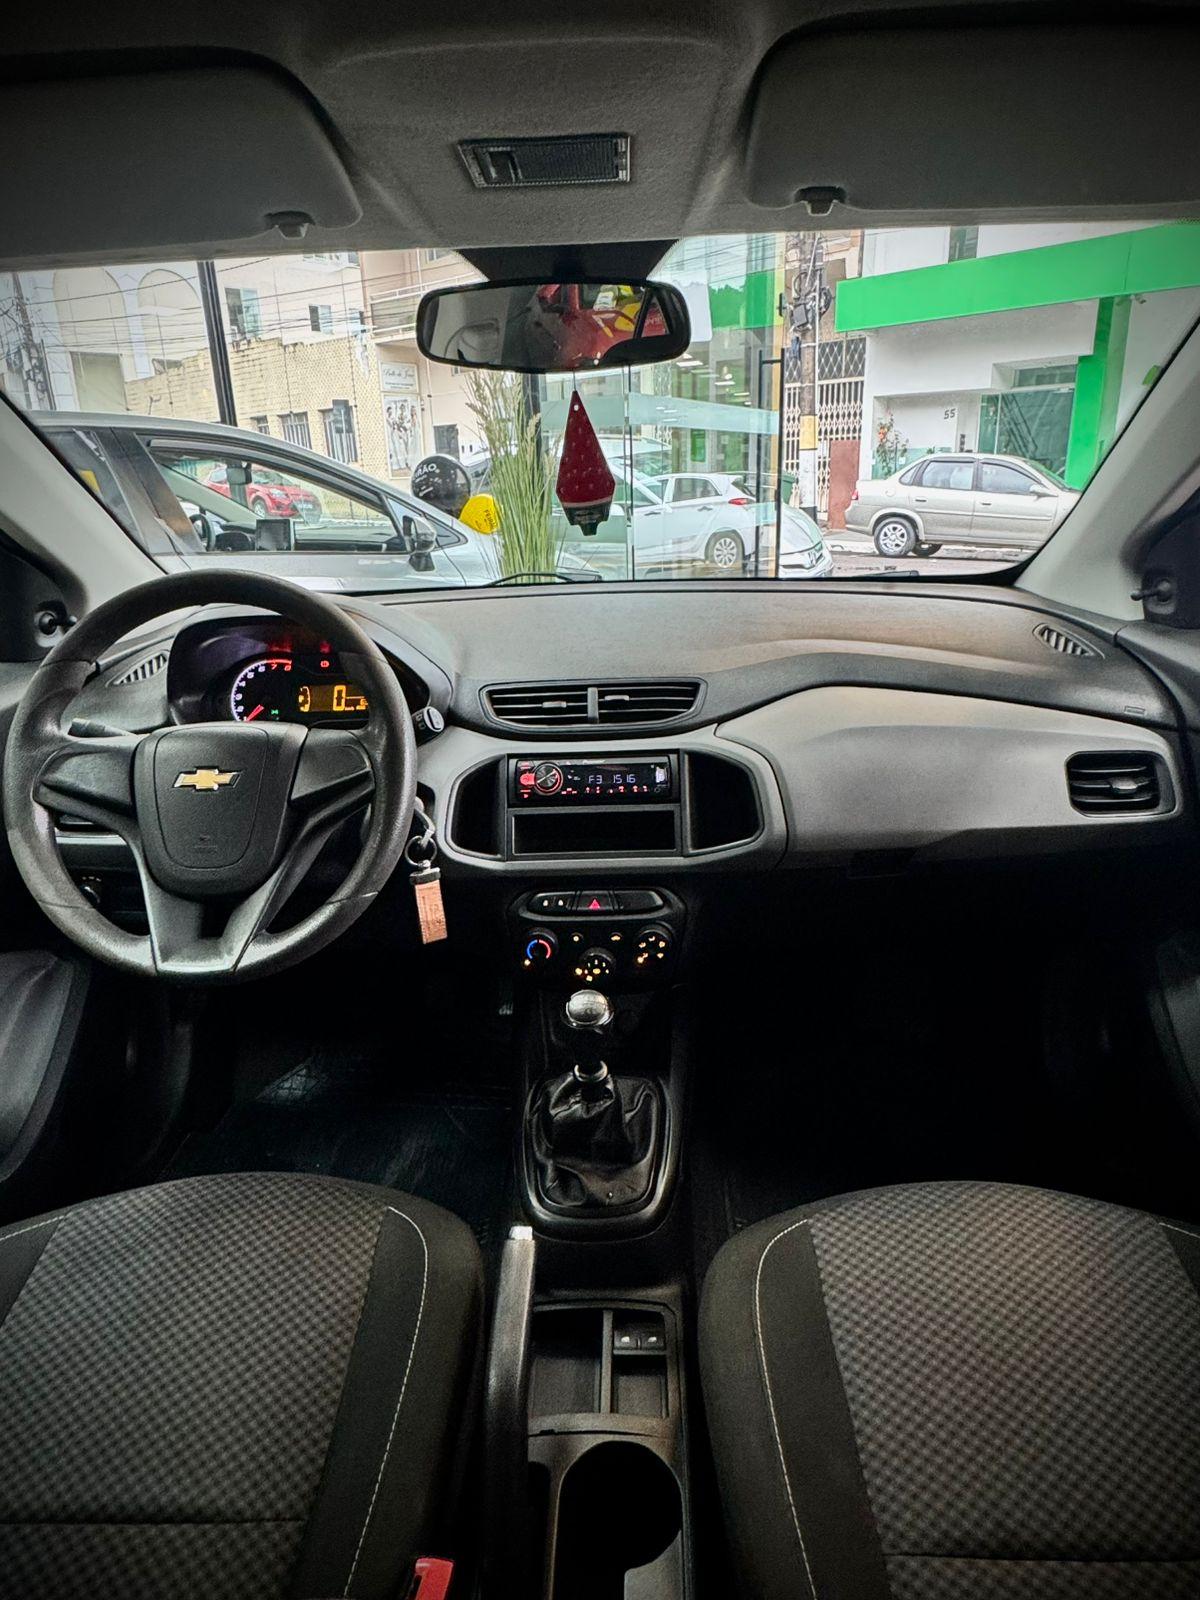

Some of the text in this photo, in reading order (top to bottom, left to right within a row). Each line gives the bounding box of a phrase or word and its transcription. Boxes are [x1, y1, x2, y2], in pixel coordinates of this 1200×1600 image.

[944, 408, 956, 420] 55
[333, 685, 346, 711] 0
[588, 775, 603, 784] F3
